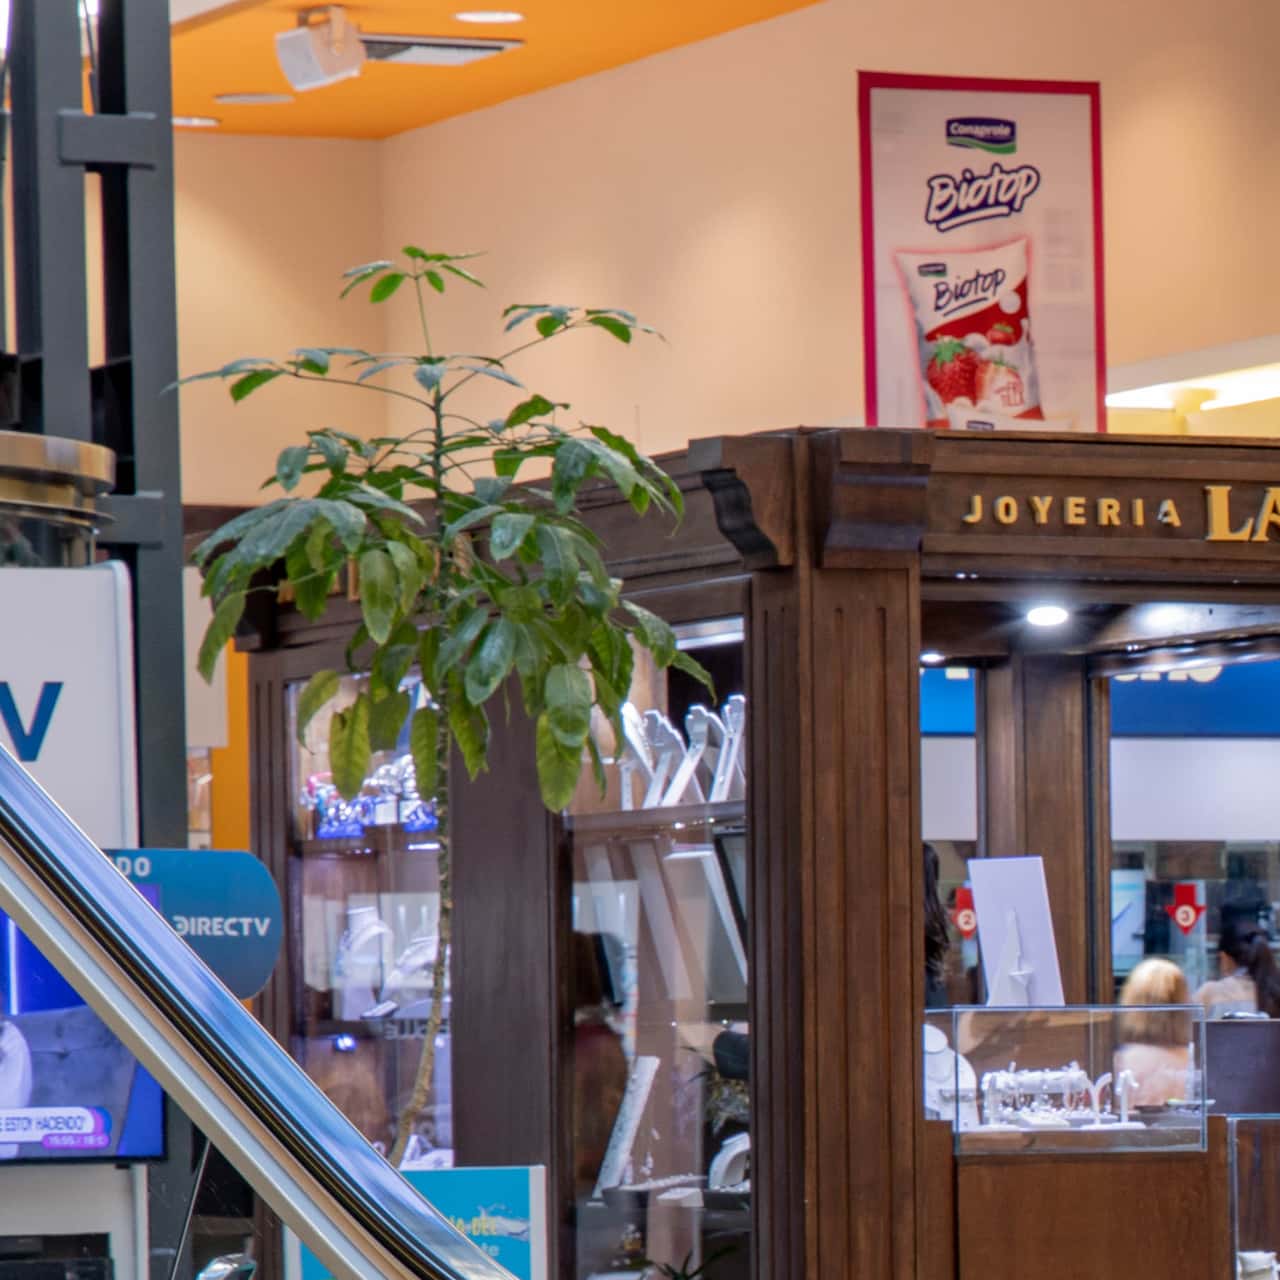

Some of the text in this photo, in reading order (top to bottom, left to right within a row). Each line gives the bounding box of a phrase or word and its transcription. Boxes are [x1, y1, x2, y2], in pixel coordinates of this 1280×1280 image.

[925, 162, 1040, 226] Biotop
[933, 268, 1006, 312] Biotop
[963, 494, 1181, 527] JOYERIA
[173, 917, 271, 936] DIRECTV
[1181, 909, 1191, 923] 3
